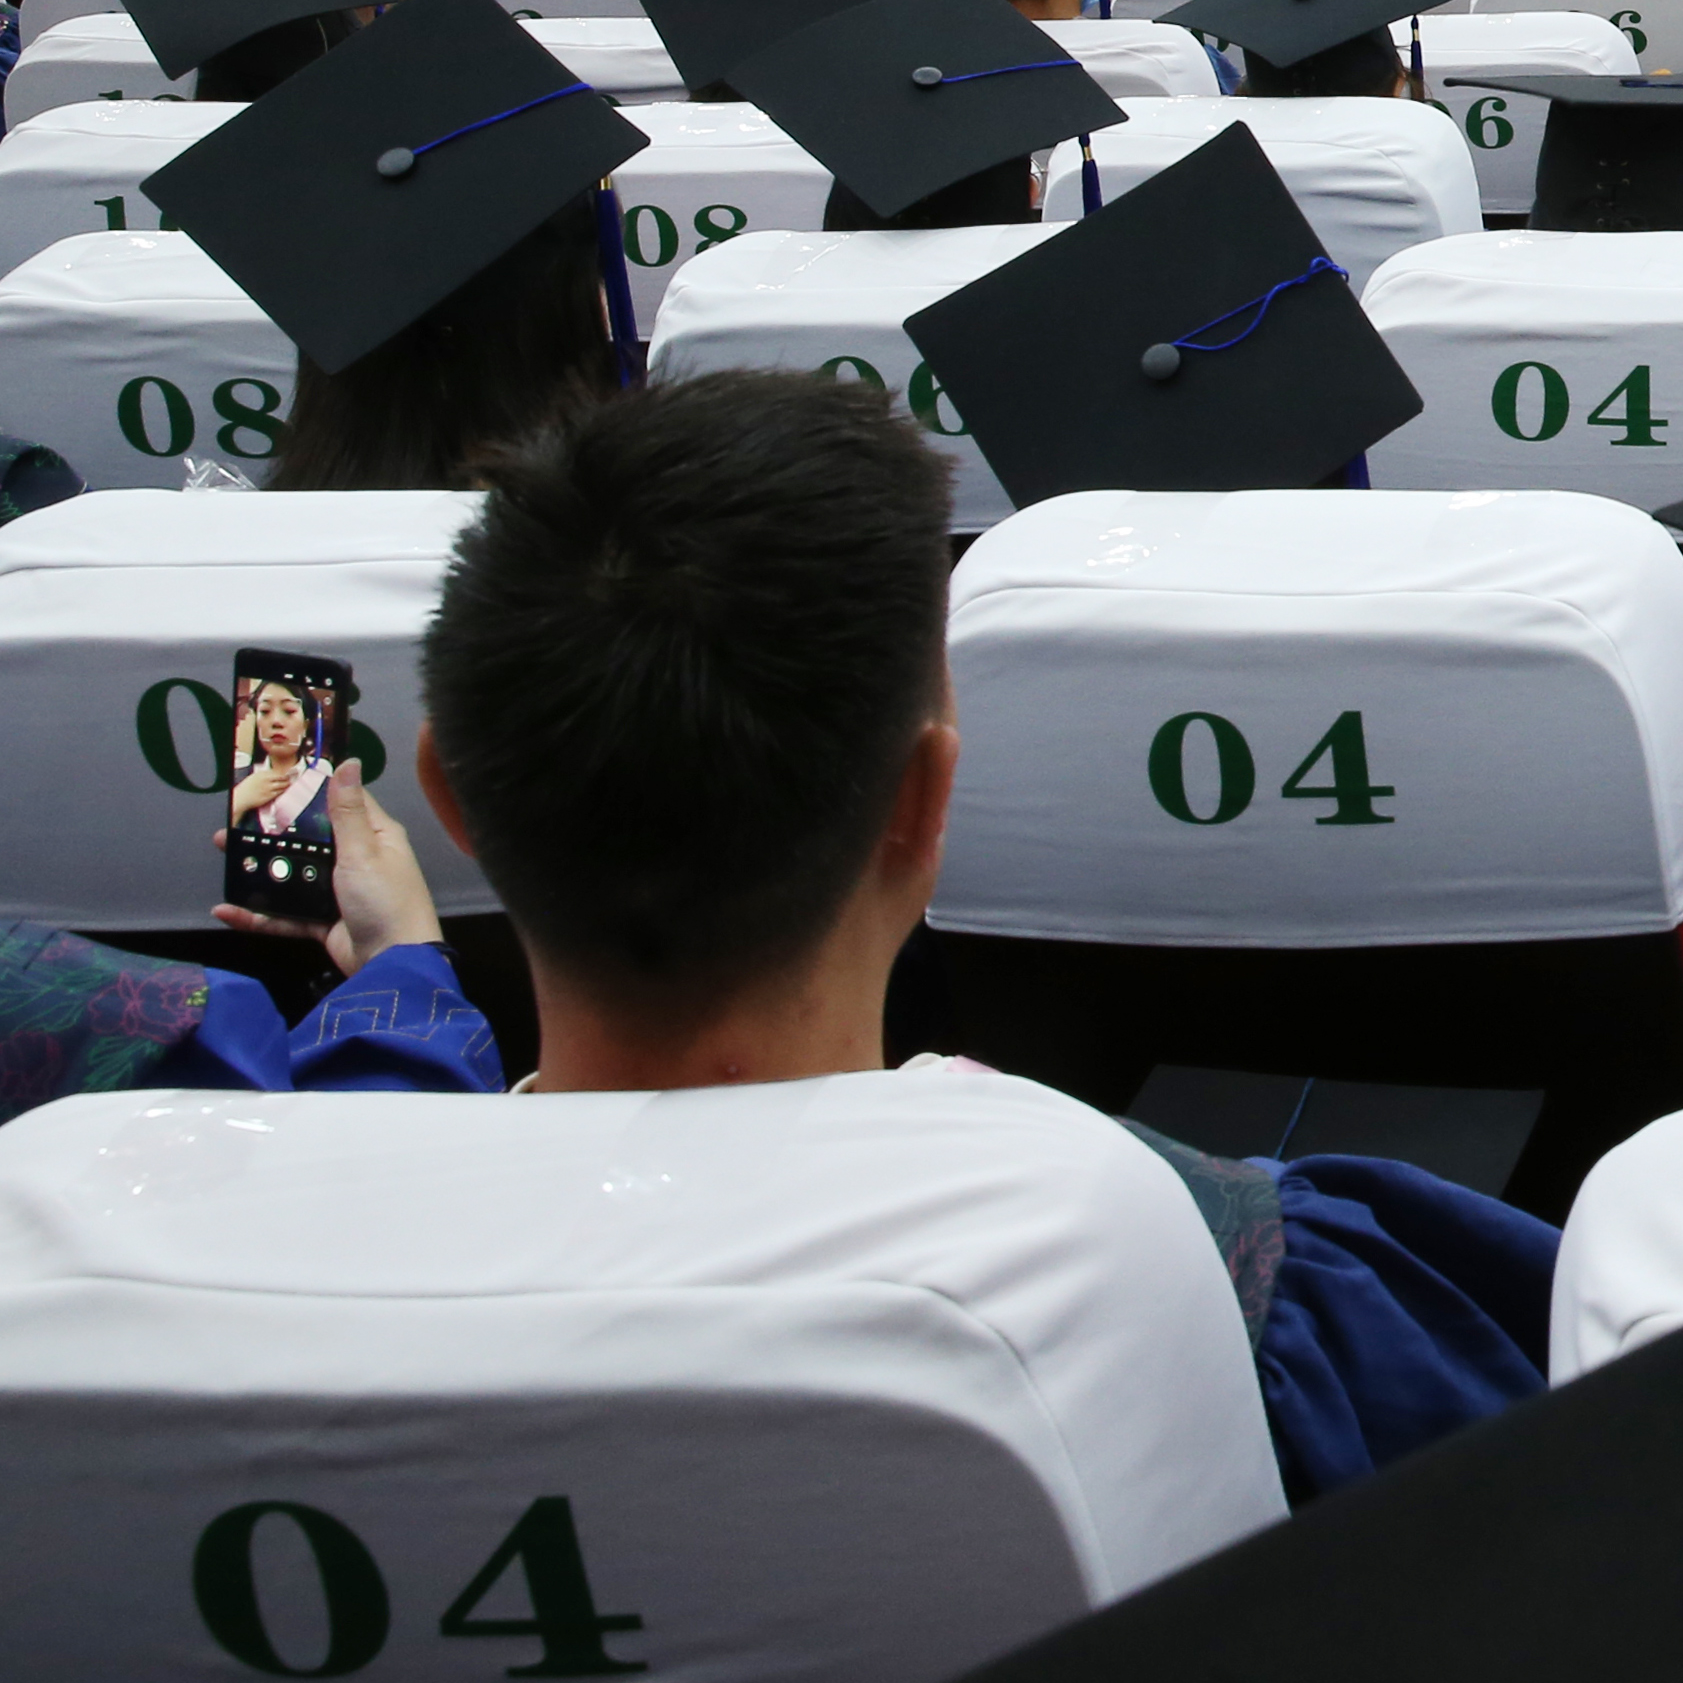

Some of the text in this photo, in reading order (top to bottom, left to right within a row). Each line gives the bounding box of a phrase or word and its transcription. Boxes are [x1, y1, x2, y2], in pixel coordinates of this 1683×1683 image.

[1608, 9, 1648, 55] 6
[1426, 96, 1515, 150] 6
[623, 204, 749, 267] 08
[117, 375, 283, 460] 08
[1491, 360, 1670, 447] 04
[1147, 710, 1397, 826] 04
[190, 1495, 650, 1679] 04
